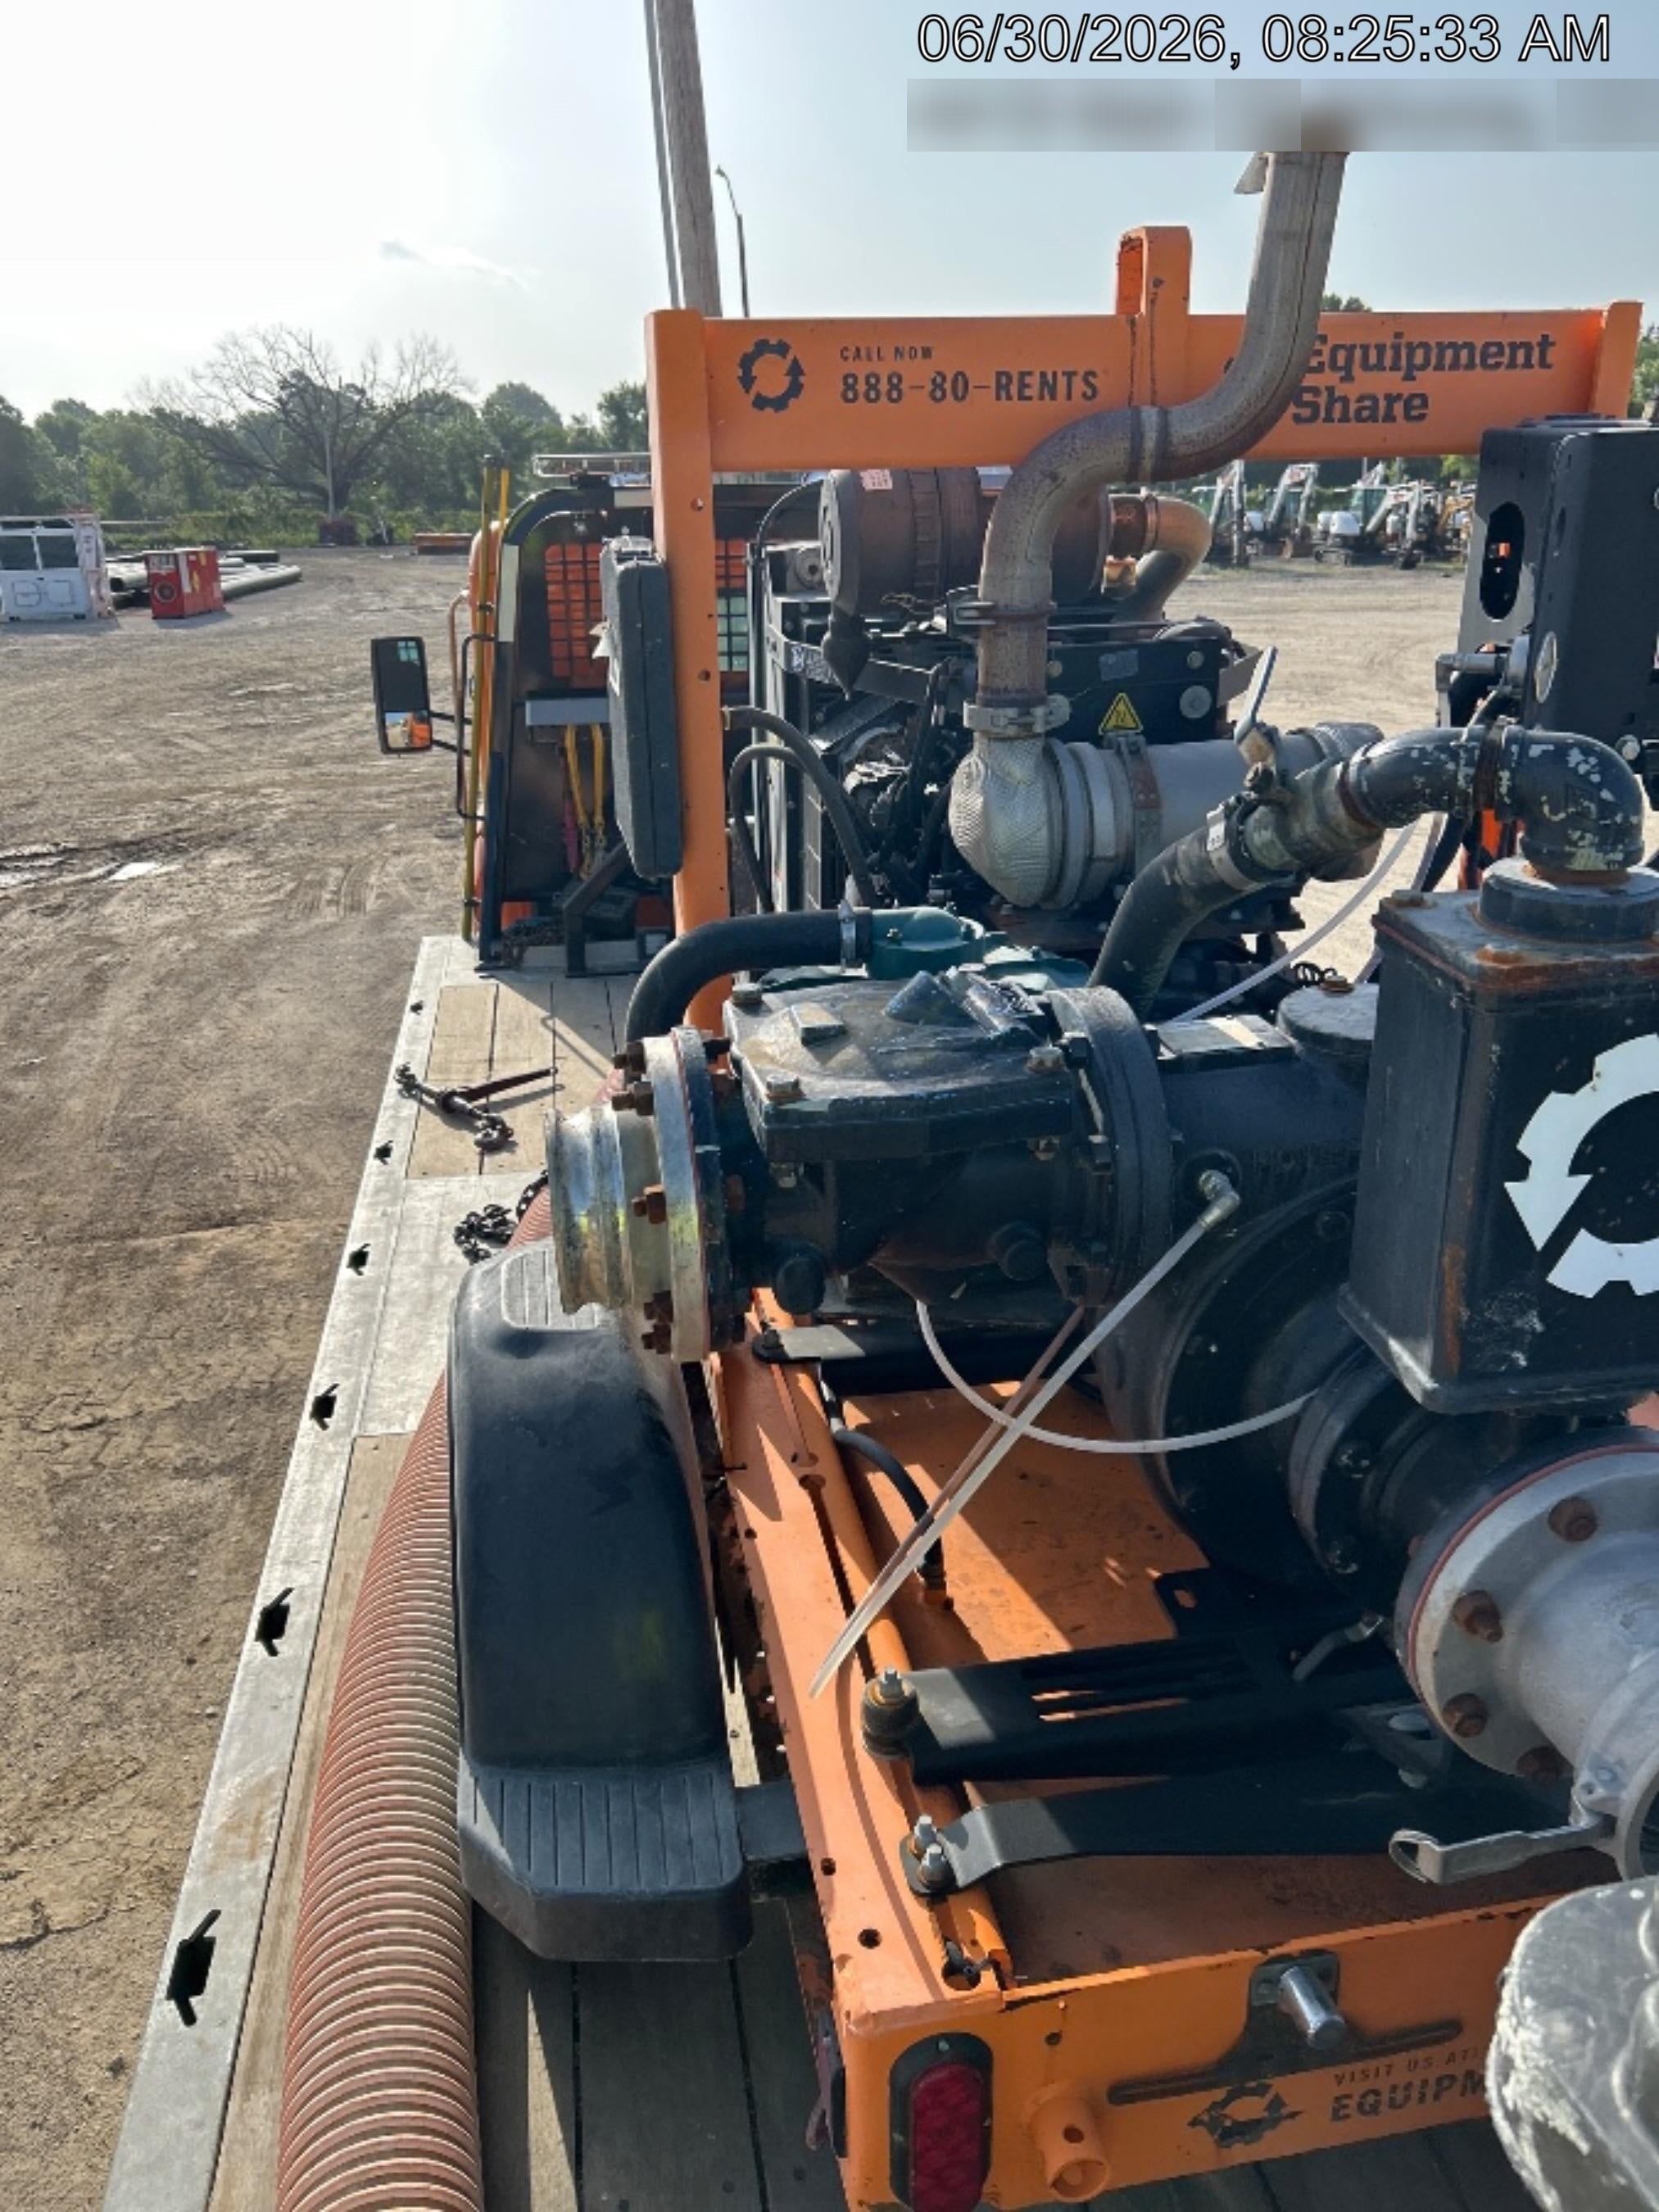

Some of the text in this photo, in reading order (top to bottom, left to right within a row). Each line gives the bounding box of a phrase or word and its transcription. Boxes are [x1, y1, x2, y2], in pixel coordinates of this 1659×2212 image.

[840, 345, 934, 360] CALL NOW
[1308, 332, 1555, 382] Equipment
[841, 370, 1099, 404] 888-80-RENTS
[1292, 385, 1430, 425] Share
[1334, 2064, 1394, 2087] VISIT
[1407, 2056, 1434, 2072] US
